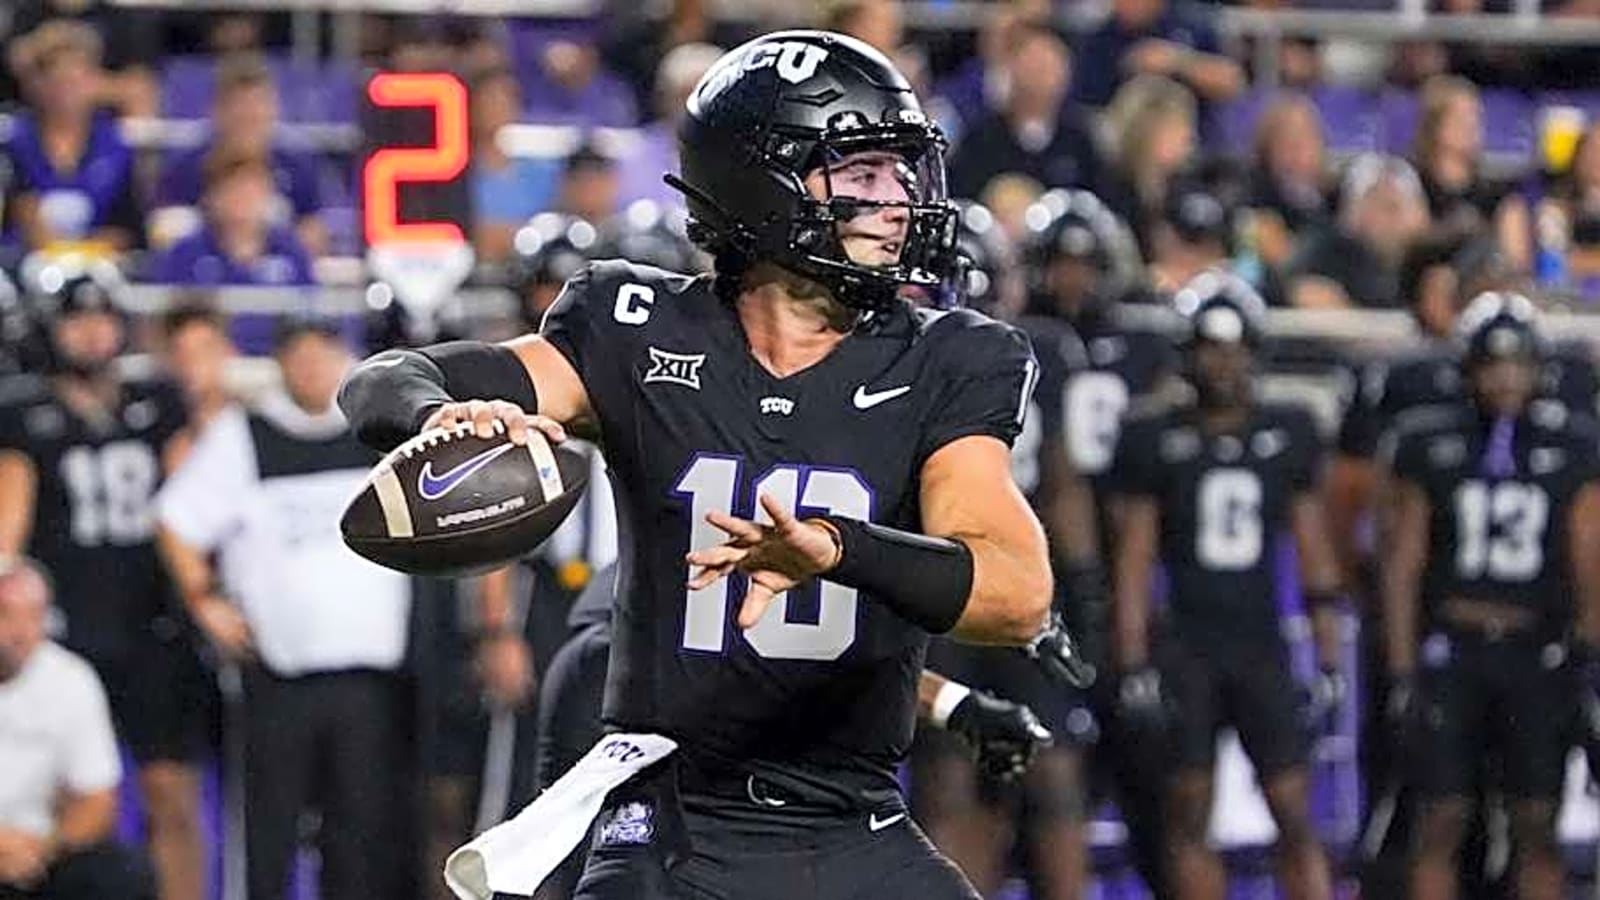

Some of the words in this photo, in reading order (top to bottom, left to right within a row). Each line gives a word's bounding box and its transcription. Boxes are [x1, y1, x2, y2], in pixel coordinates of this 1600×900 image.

[364, 72, 470, 247] 2
[614, 282, 655, 325] C
[759, 396, 798, 416] TCU
[61, 440, 157, 547] 18
[1454, 479, 1549, 581] 13
